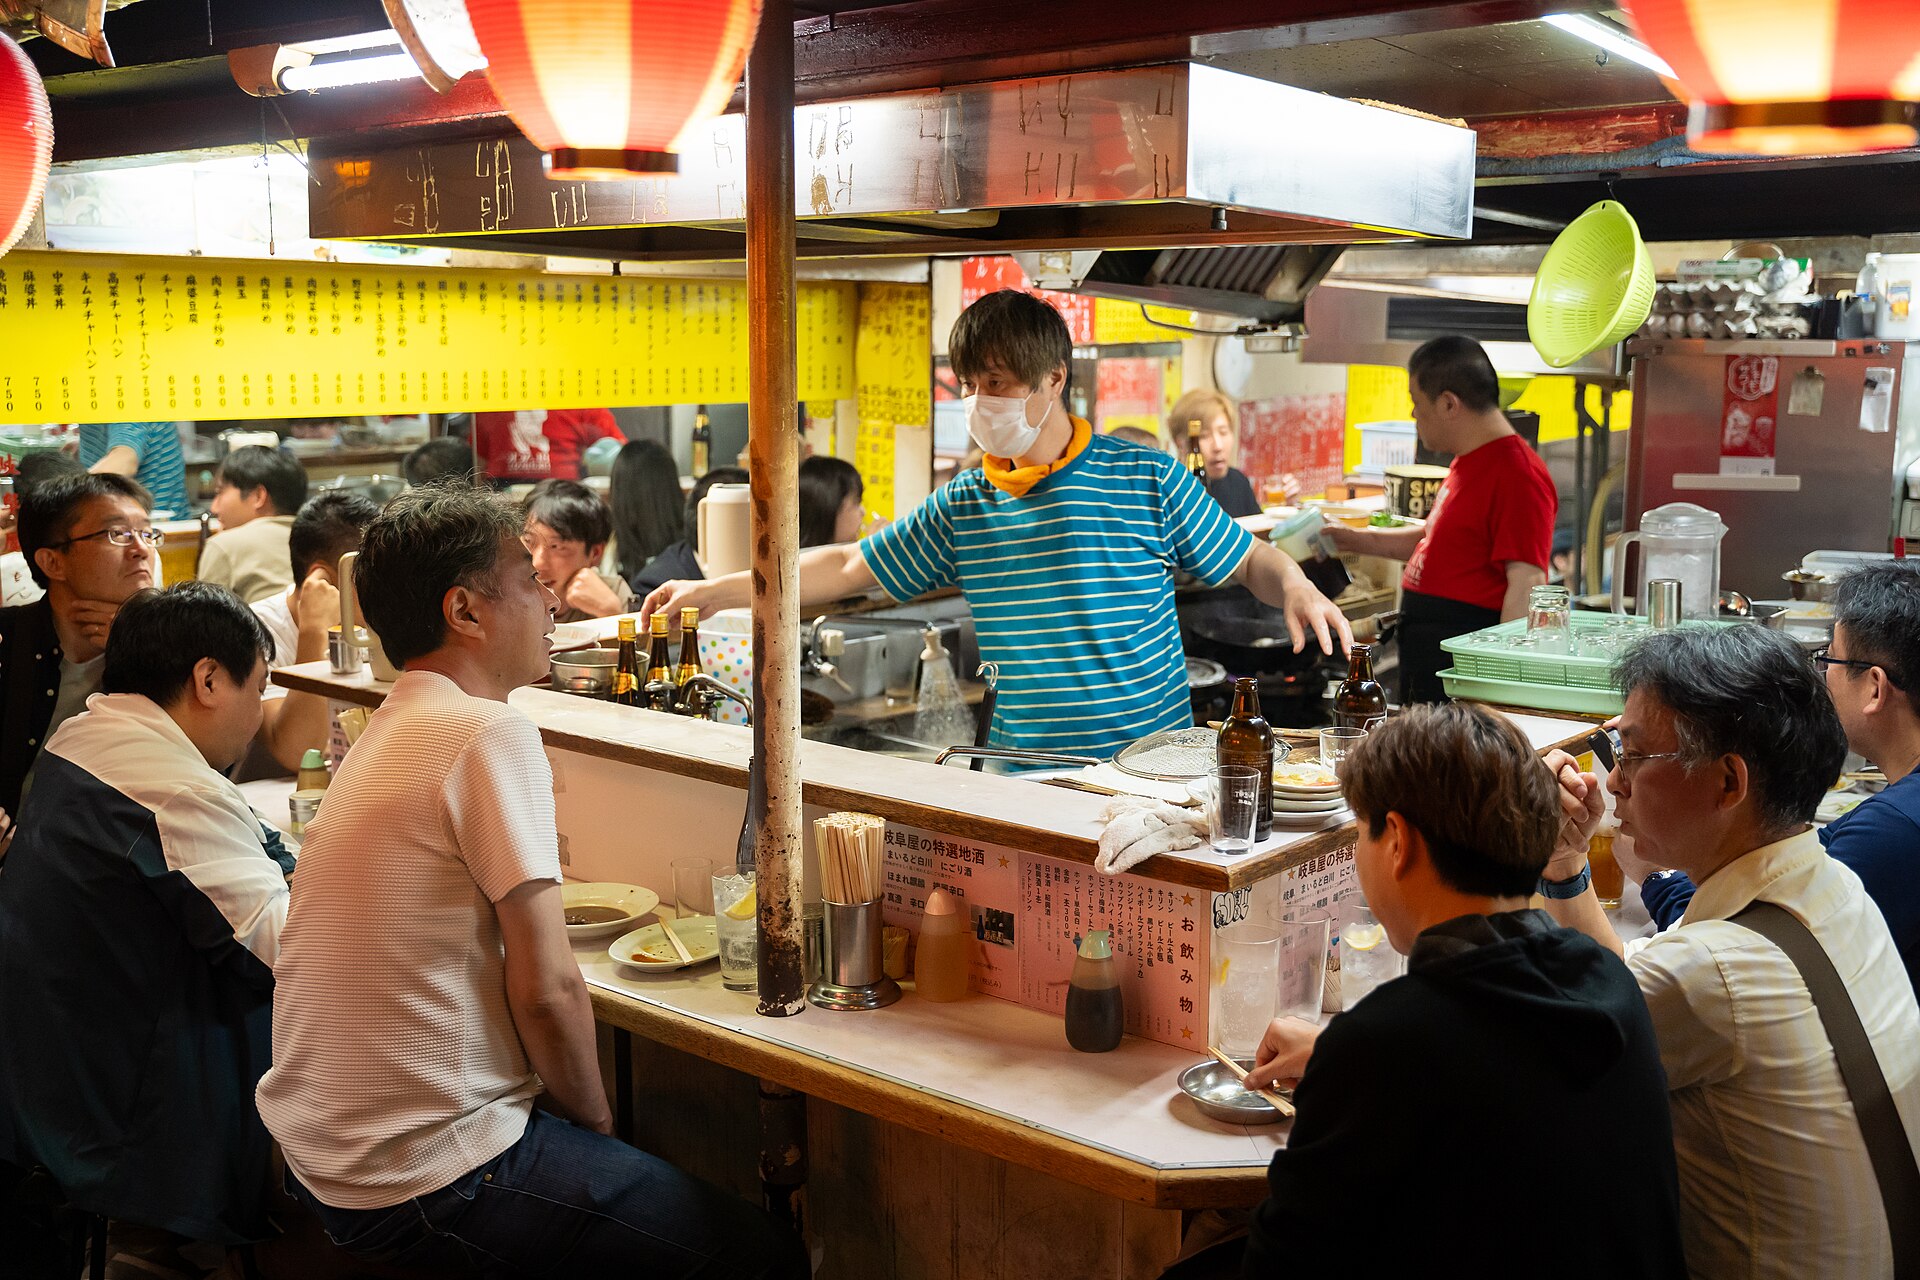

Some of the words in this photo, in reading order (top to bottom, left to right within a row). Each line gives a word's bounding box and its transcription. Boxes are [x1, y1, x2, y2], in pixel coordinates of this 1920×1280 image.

[108, 272, 123, 358] 高菜チャーハン
[186, 275, 198, 324] 麻婆豆腐
[23, 269, 37, 309] 麻婆丼
[33, 376, 42, 411] 750
[81, 271, 97, 369] キムチチャーハン
[89, 376, 98, 410] 750
[134, 273, 150, 371] ザーサイチャーハン
[142, 375, 150, 409] 750
[161, 273, 174, 332] チャーハン
[168, 375, 176, 408] 650
[4, 376, 14, 411] 750
[61, 376, 70, 410] 650
[115, 376, 124, 409] 750
[885, 829, 985, 866] 岐阜屋の特選地酒
[888, 850, 933, 868] まいるど白川
[940, 862, 973, 877] にごり酒
[1298, 843, 1356, 880] 岐阜屋の特選
[1301, 872, 1335, 895] まいるど白川
[910, 898, 925, 909] 辛口
[1179, 916, 1195, 1014] お飲み物
